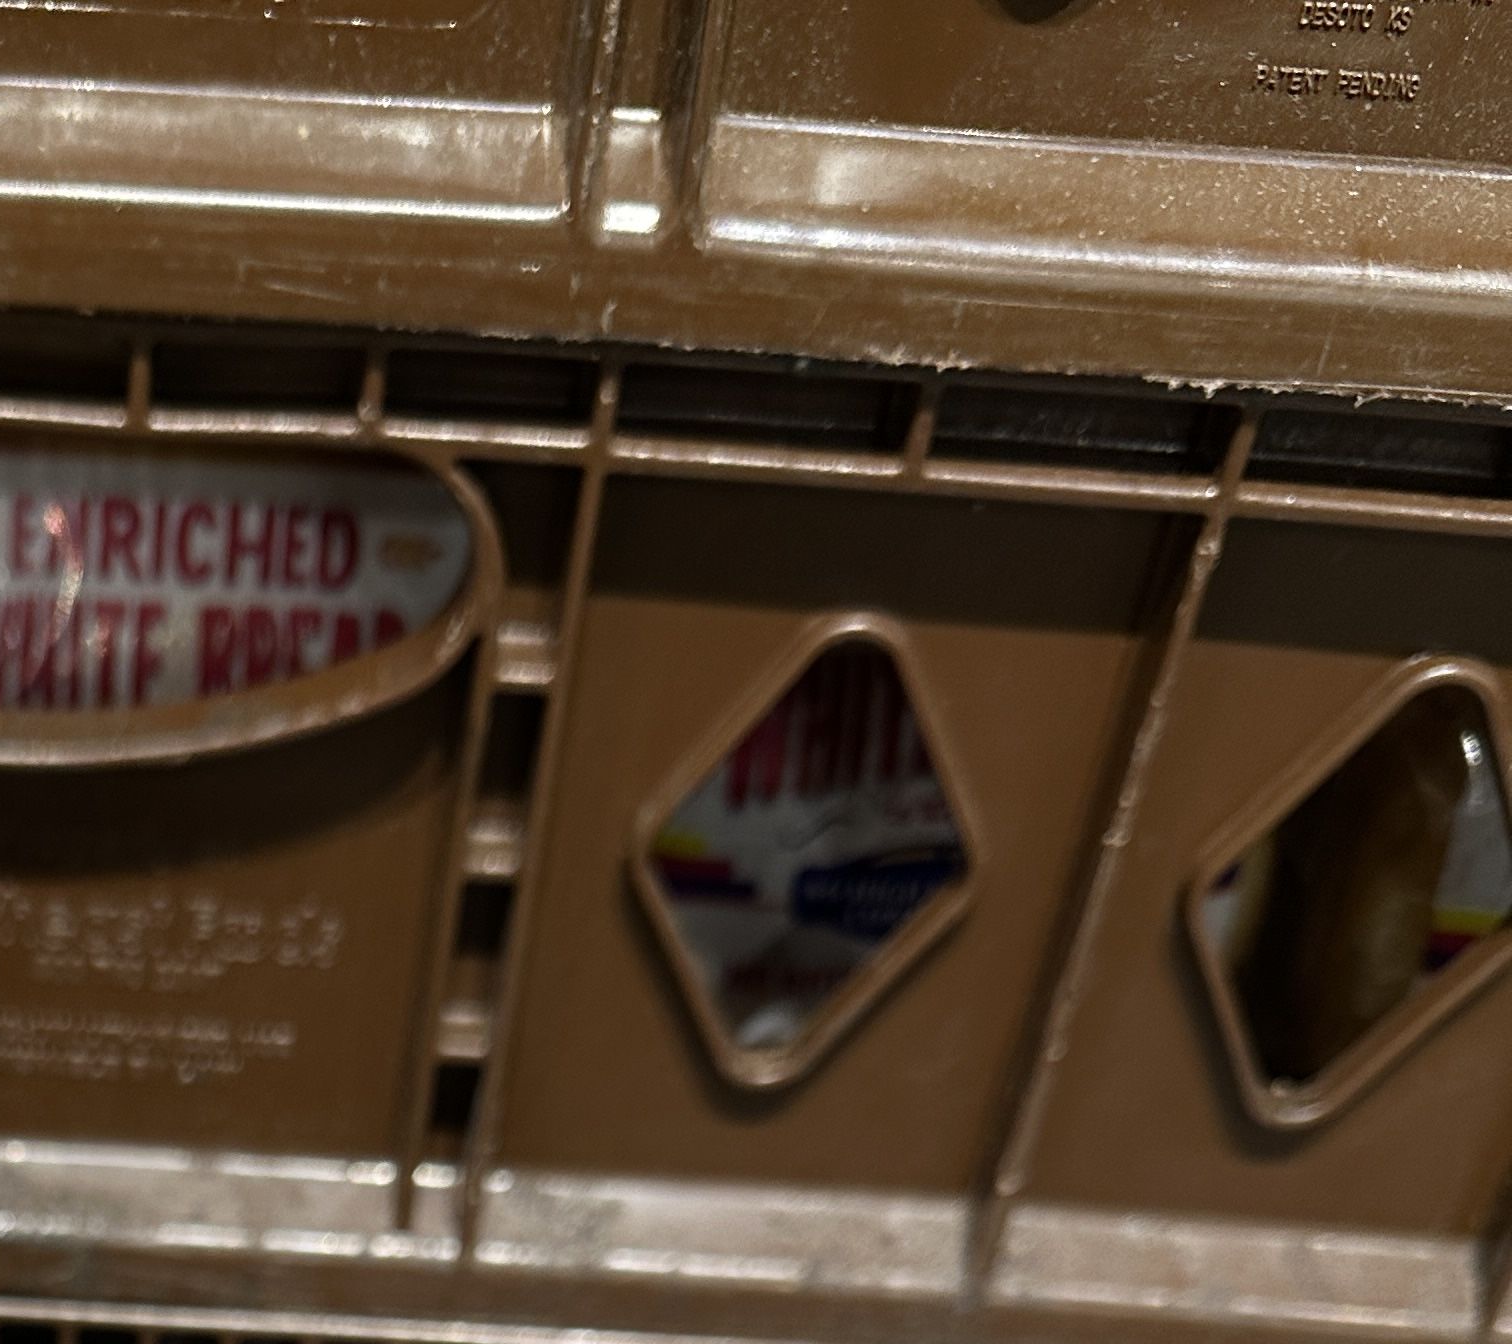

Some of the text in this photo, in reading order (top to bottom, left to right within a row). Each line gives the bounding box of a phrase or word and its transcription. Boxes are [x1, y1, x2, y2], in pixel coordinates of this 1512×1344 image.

[1298, 1, 1376, 29] DESOTO
[1253, 63, 1422, 99] PATENT PENDING
[5, 491, 361, 591] ENRICHED
